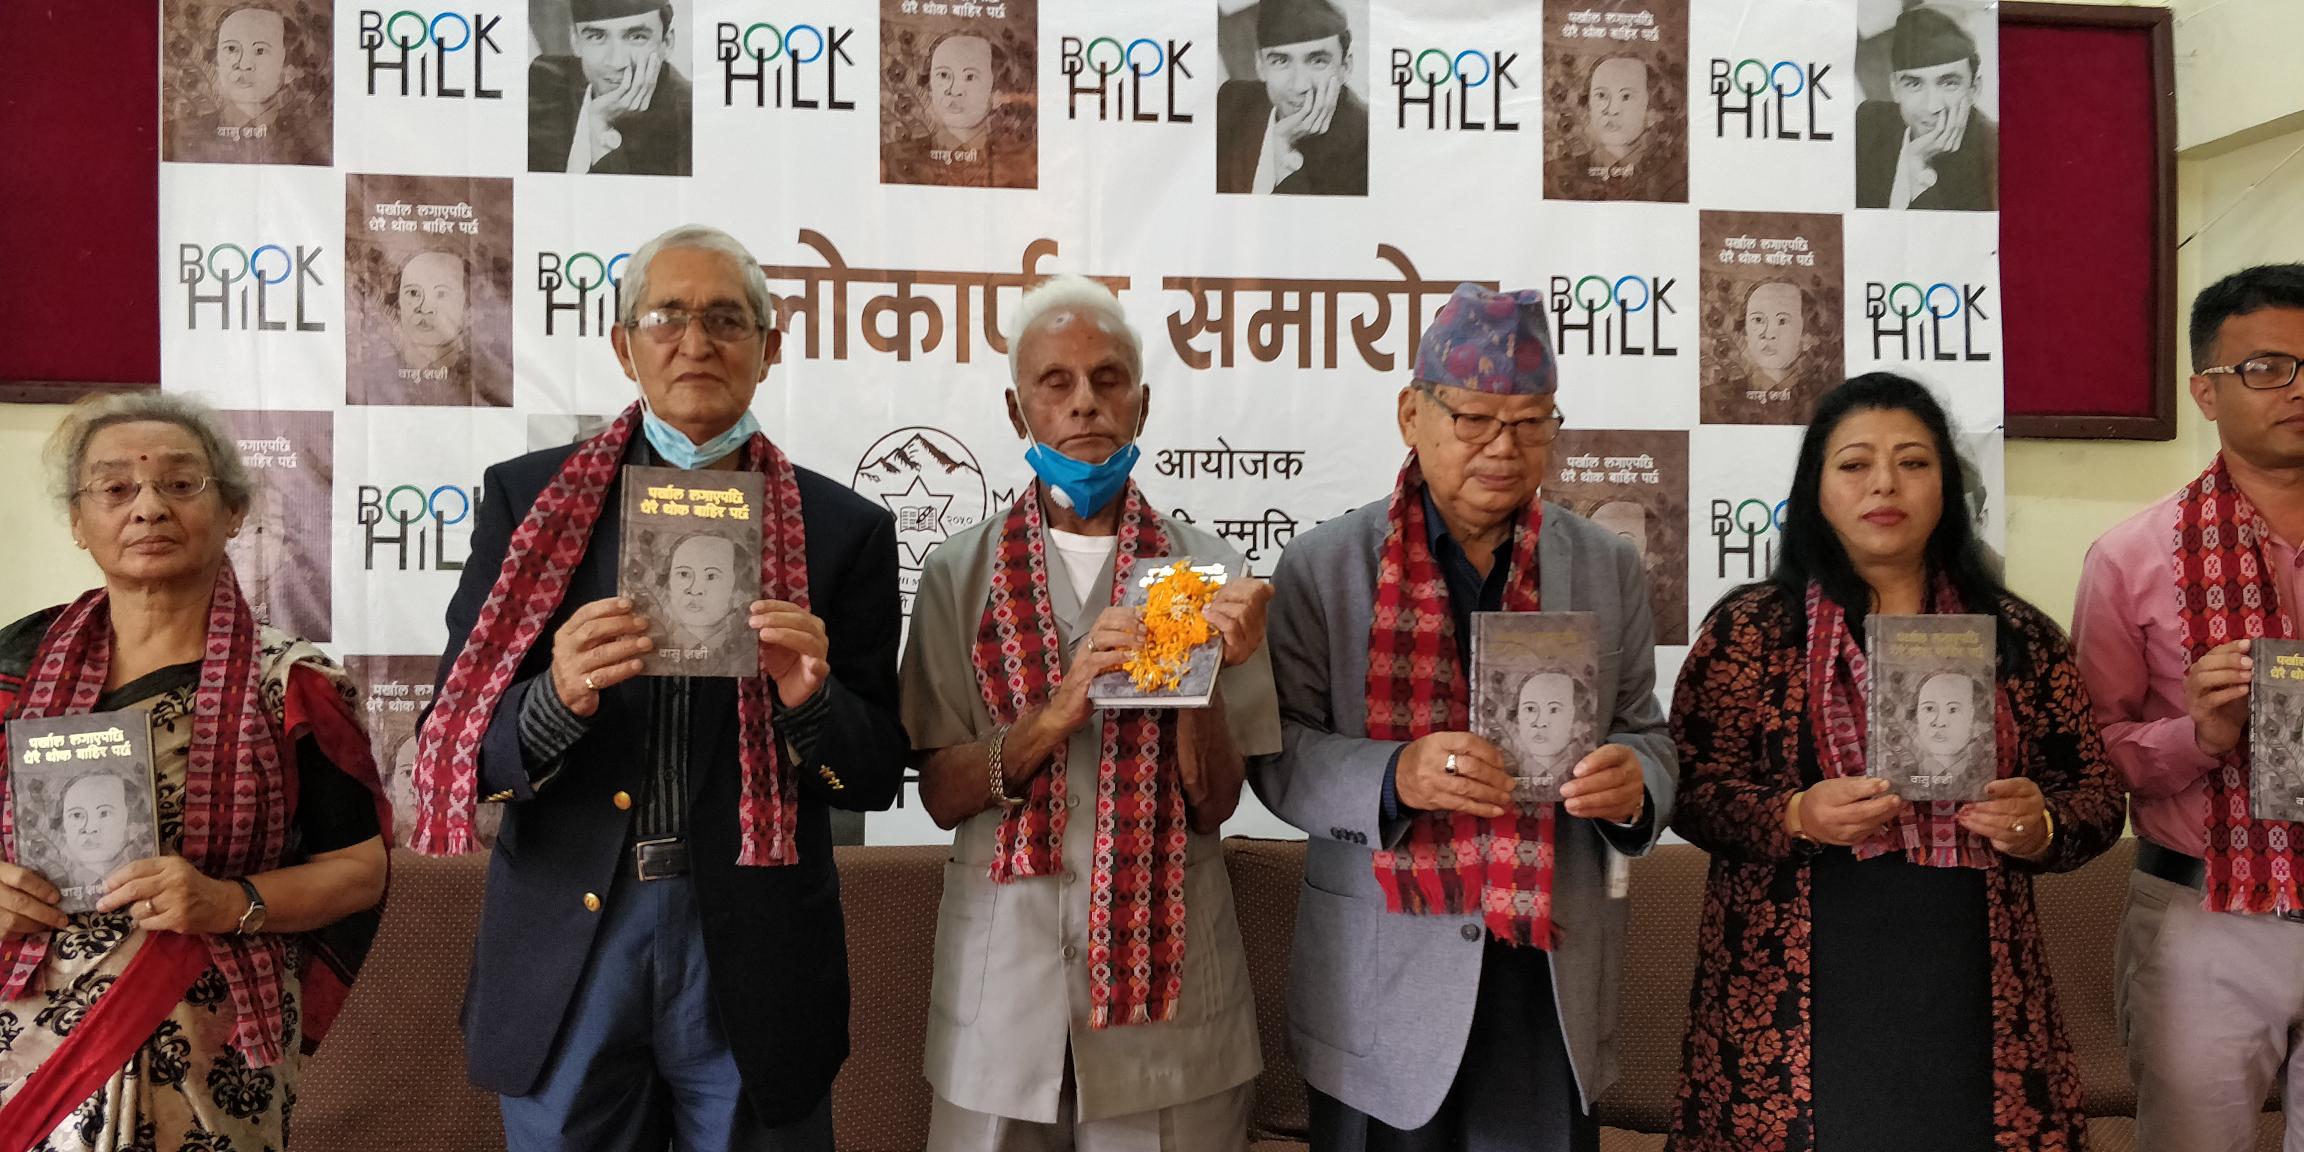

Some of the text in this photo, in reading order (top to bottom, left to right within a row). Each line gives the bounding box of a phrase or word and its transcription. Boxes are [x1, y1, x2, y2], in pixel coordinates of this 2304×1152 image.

[360, 10, 502, 54] BOOK
[718, 22, 855, 66] BOOK
[1062, 36, 1192, 79] BOOK
[1391, 48, 1520, 89] BOOK
[1711, 59, 1832, 100] BOOK
[180, 243, 324, 286] BOOK
[1162, 243, 1500, 372] समारो
[1551, 275, 1676, 313] BOOK
[1867, 282, 1988, 320] BOOK
[1156, 436, 1306, 480] आयोजक
[1214, 508, 1298, 560] स्मृति
[1711, 499, 1789, 536] BO
